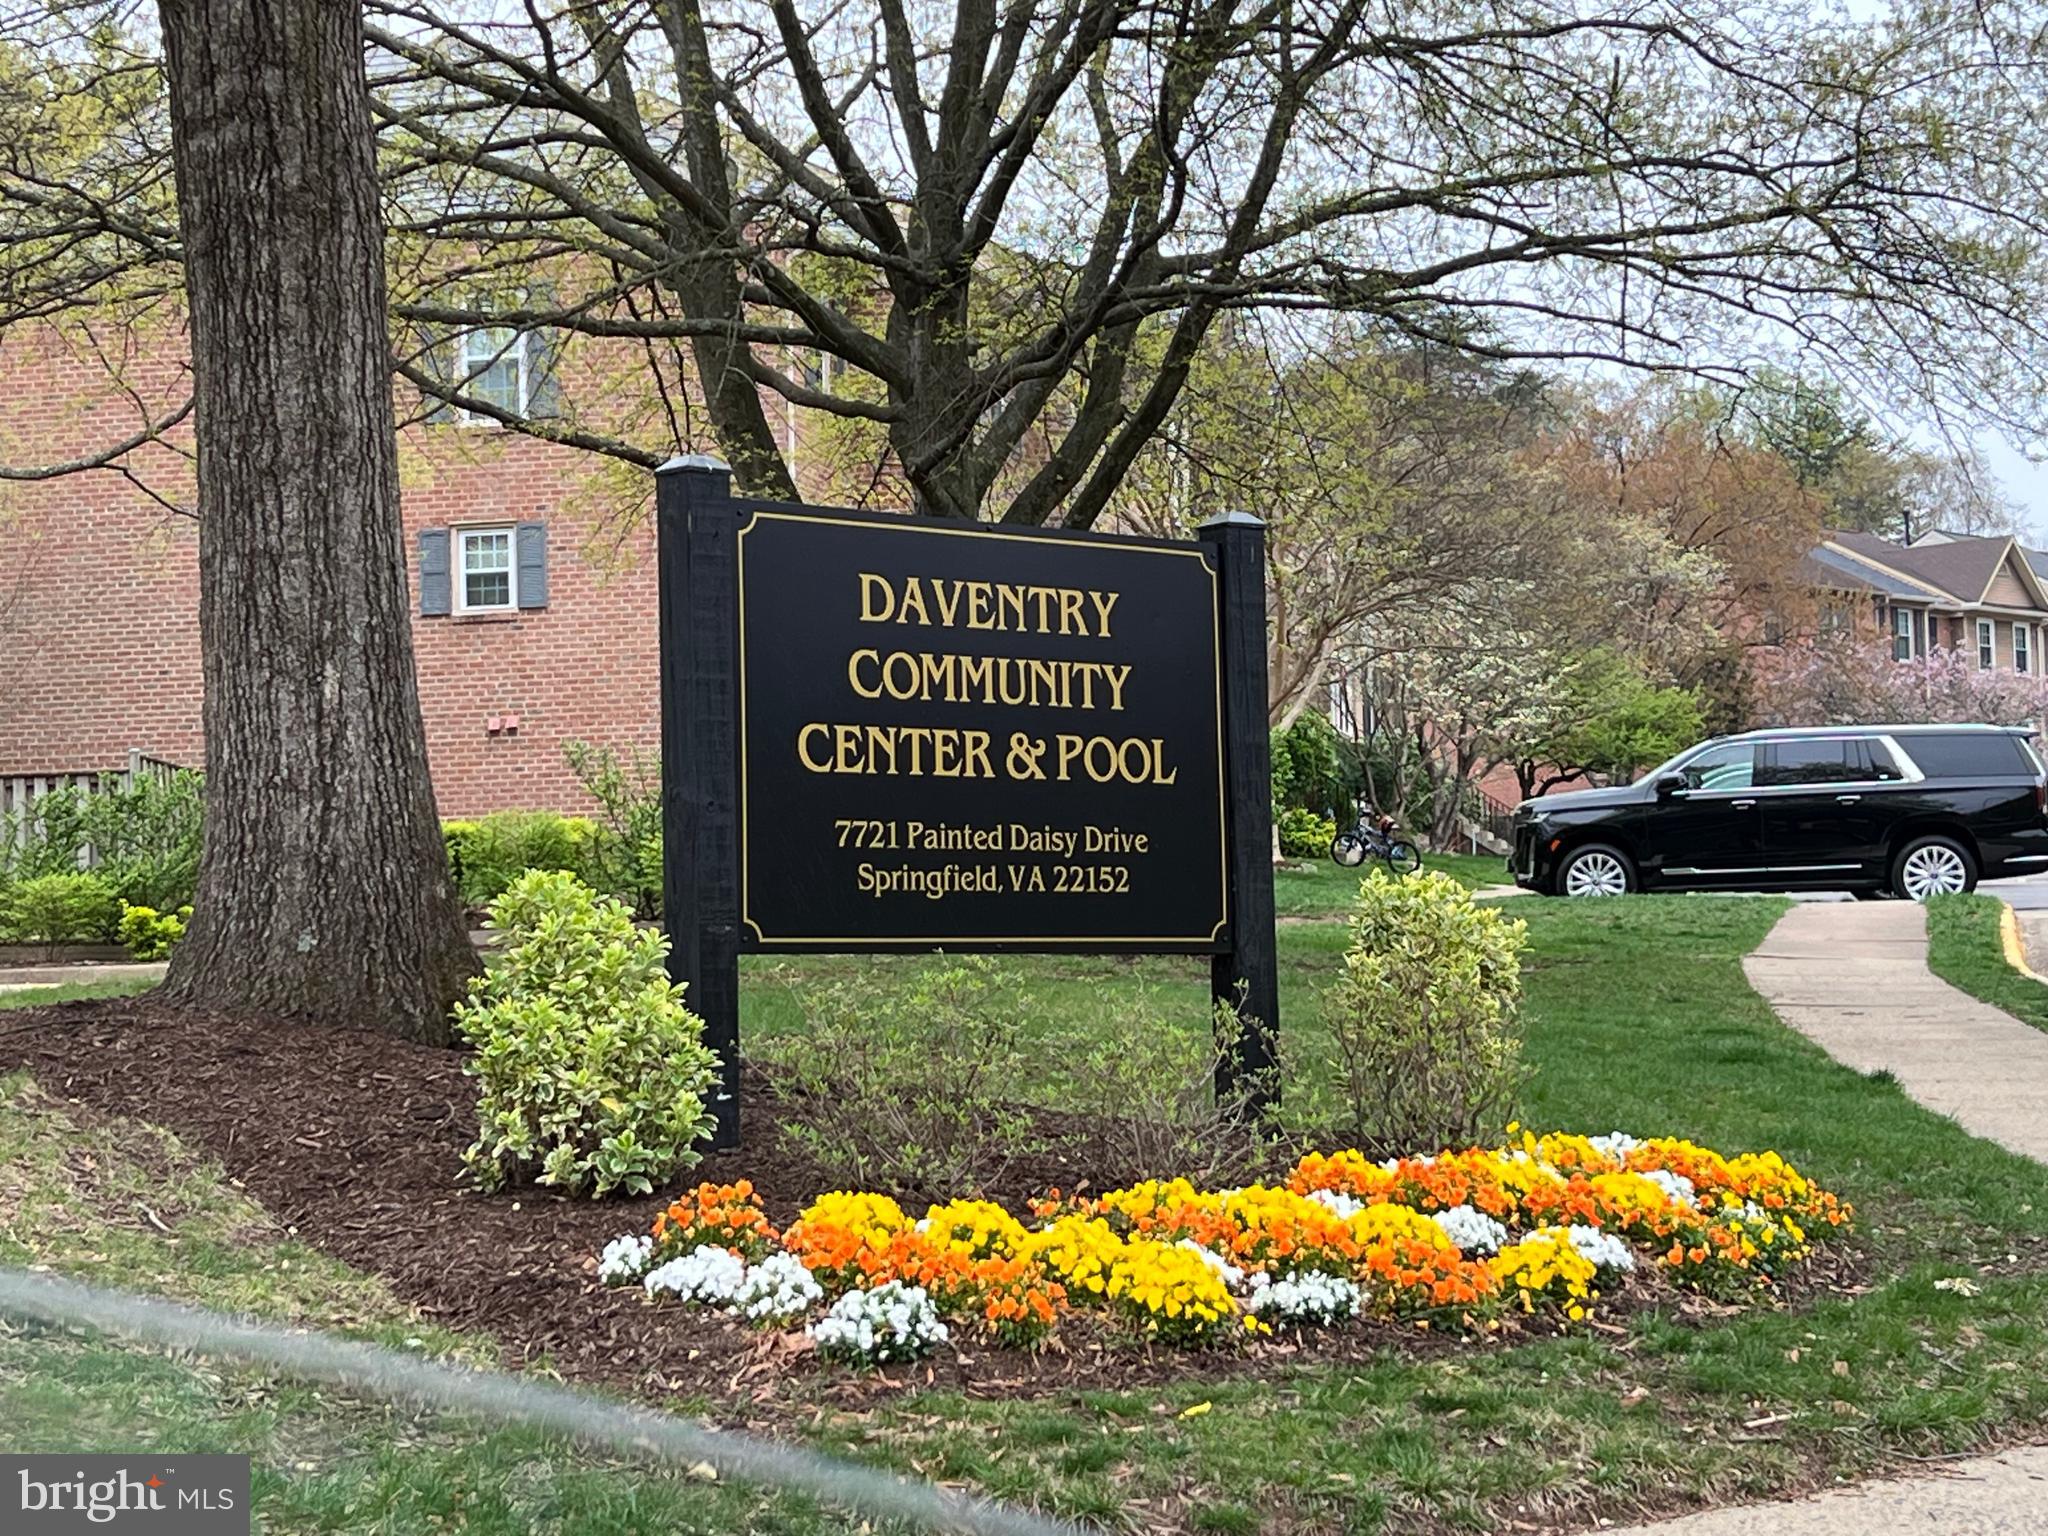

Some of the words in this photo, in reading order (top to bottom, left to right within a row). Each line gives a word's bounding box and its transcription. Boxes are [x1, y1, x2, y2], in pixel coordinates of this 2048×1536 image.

[858, 572, 1120, 638] DAVENTRY
[848, 648, 1133, 711] COMMUNITY
[797, 722, 996, 779] CENTER
[1005, 732, 1047, 781] &
[1055, 734, 1178, 785] POOL
[834, 819, 900, 849] 7721
[906, 821, 1003, 851] Painted
[1009, 824, 1078, 859] Daisy
[1084, 825, 1149, 853] Drive
[857, 863, 1004, 900] Springfield,
[1007, 864, 1046, 892] VA
[1053, 865, 1130, 893] 22152
